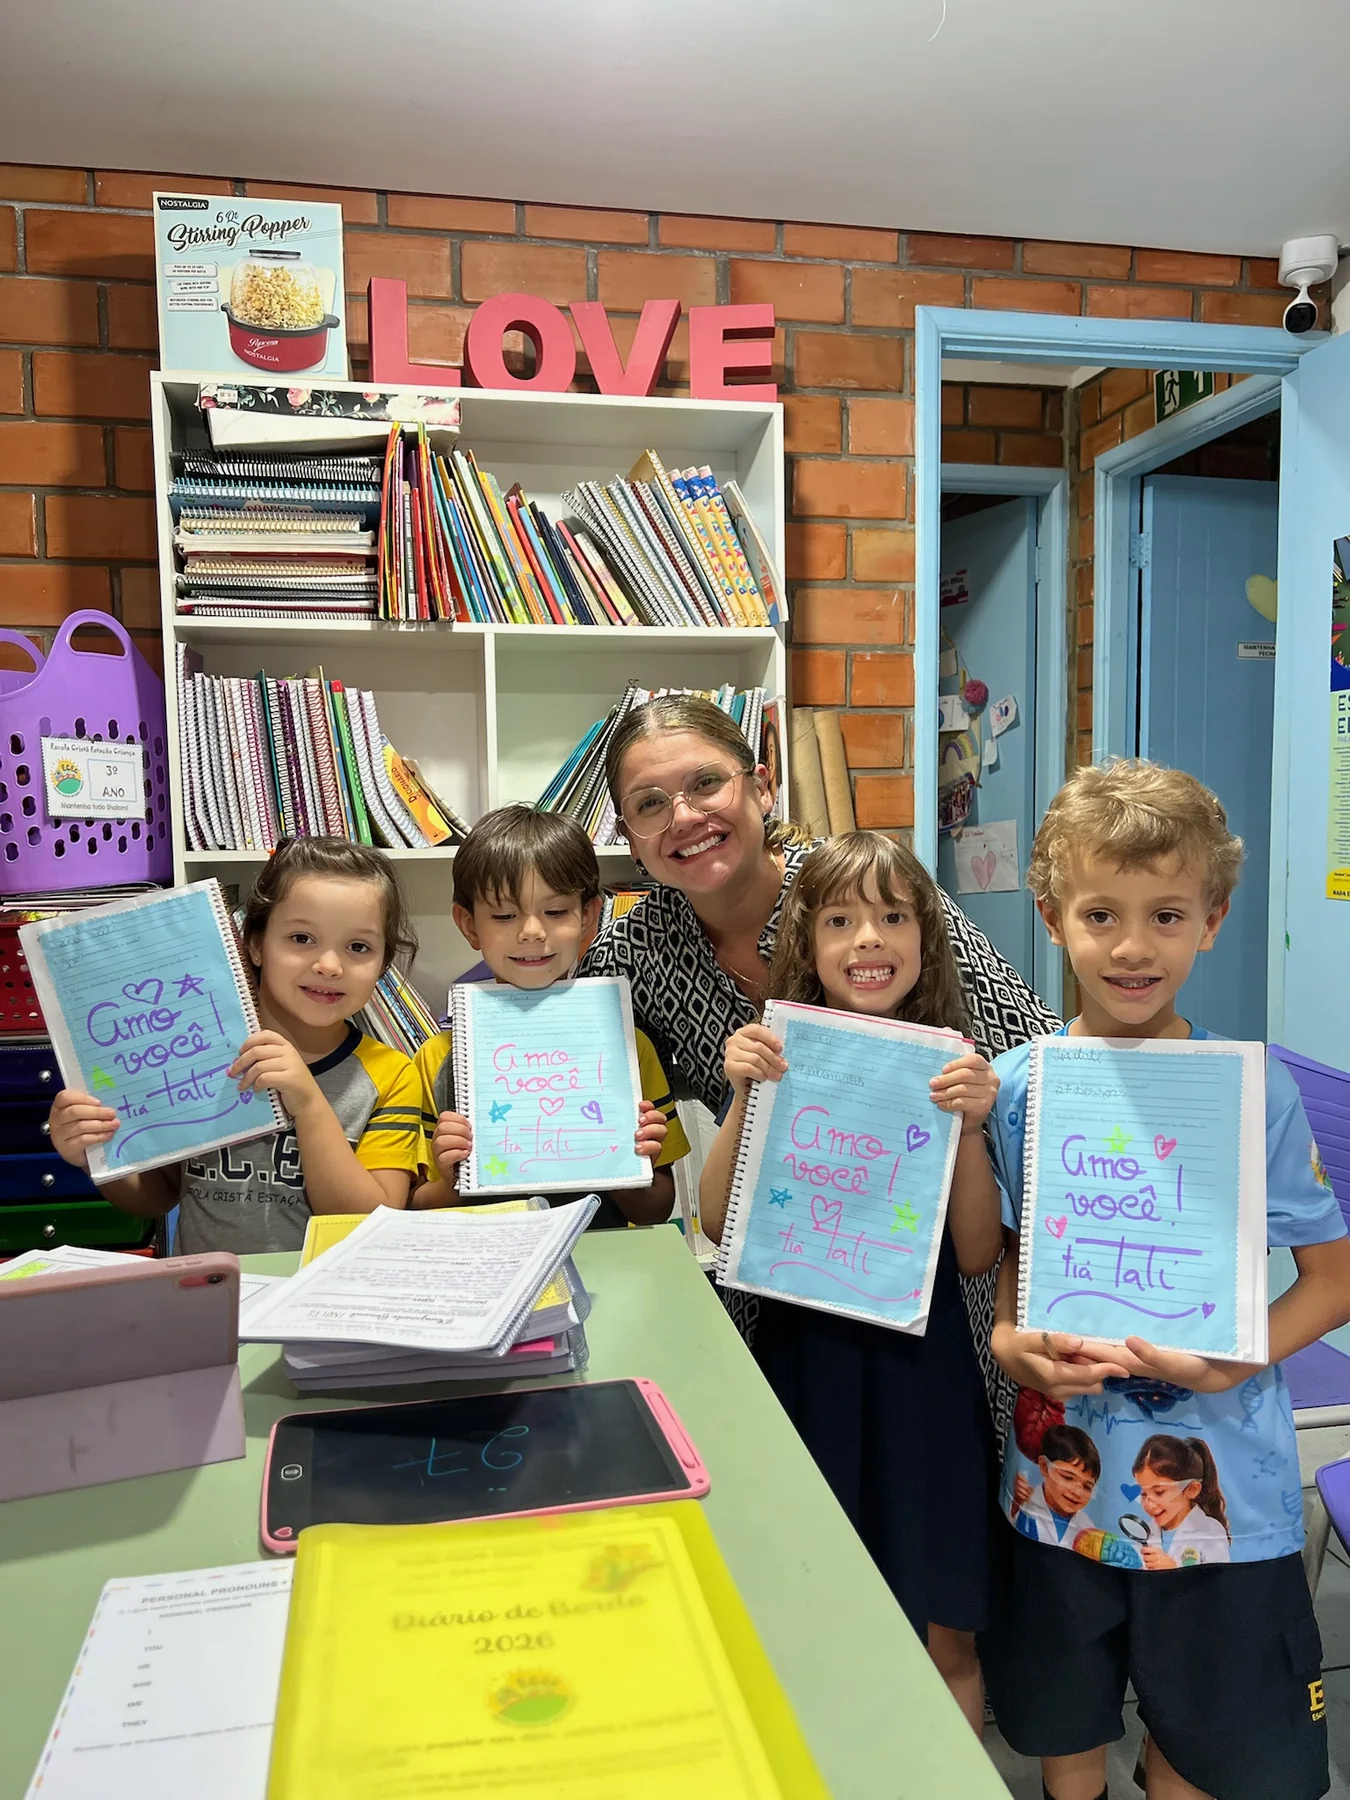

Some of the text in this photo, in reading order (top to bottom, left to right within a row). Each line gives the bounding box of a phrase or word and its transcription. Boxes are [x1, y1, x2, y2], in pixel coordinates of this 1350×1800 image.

[160, 199, 208, 209] NOSTALGIA
[216, 212, 224, 223] 6
[167, 214, 311, 252] Stirring Popper
[367, 276, 778, 403] LOVE
[244, 349, 280, 362] NOSTALGIA
[51, 742, 70, 751] Escola
[102, 787, 125, 798] ANO
[87, 1001, 182, 1046] Amo
[493, 1044, 578, 1072] Amo
[791, 1105, 891, 1160] Amo
[1062, 1135, 1147, 1180] Amo
[212, 1189, 253, 1203] CRISTÃ
[141, 1591, 207, 1604] PERSONAL
[210, 1581, 278, 1595] PRONOUNS
[391, 1604, 499, 1632] Diário
[504, 1600, 544, 1621] de
[473, 1631, 556, 1656] 2026
